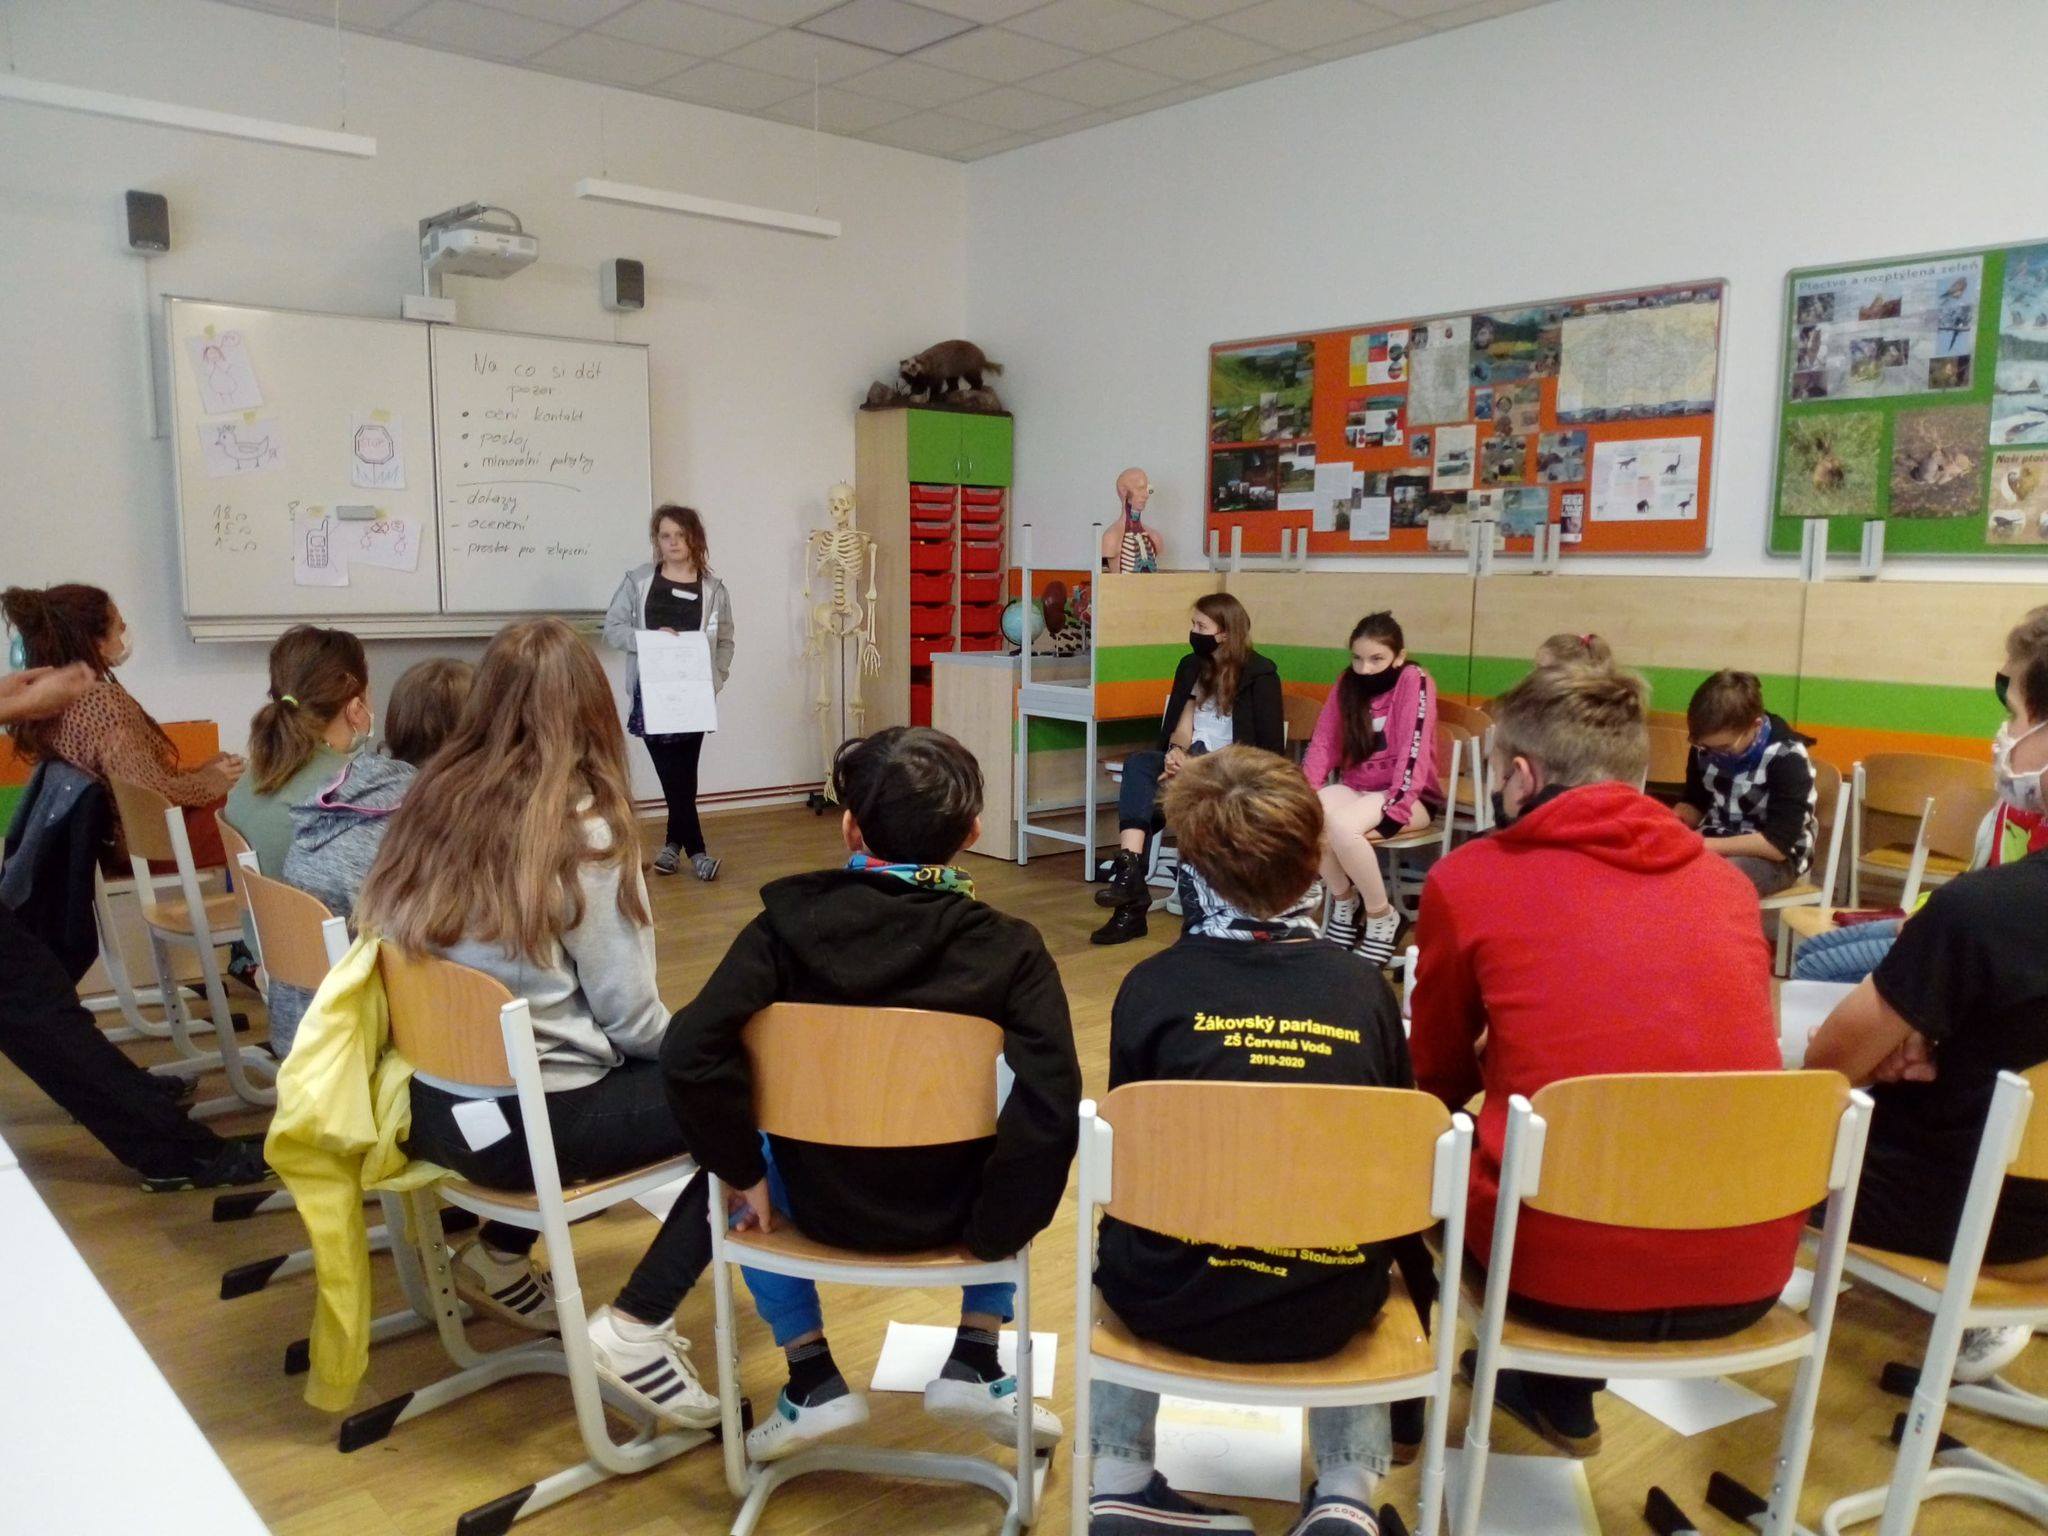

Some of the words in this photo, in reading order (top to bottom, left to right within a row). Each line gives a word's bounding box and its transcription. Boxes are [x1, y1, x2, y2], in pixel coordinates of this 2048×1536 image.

[474, 352, 497, 375] Na
[514, 364, 536, 377] co
[1193, 1012, 1275, 1034] Žákovský
[1279, 1019, 1361, 1044] parlament
[1223, 1032, 1242, 1047] ZŠ
[1244, 1033, 1299, 1051] Červená
[1300, 1039, 1333, 1056] Voda
[1249, 1053, 1306, 1069] 2019-2020
